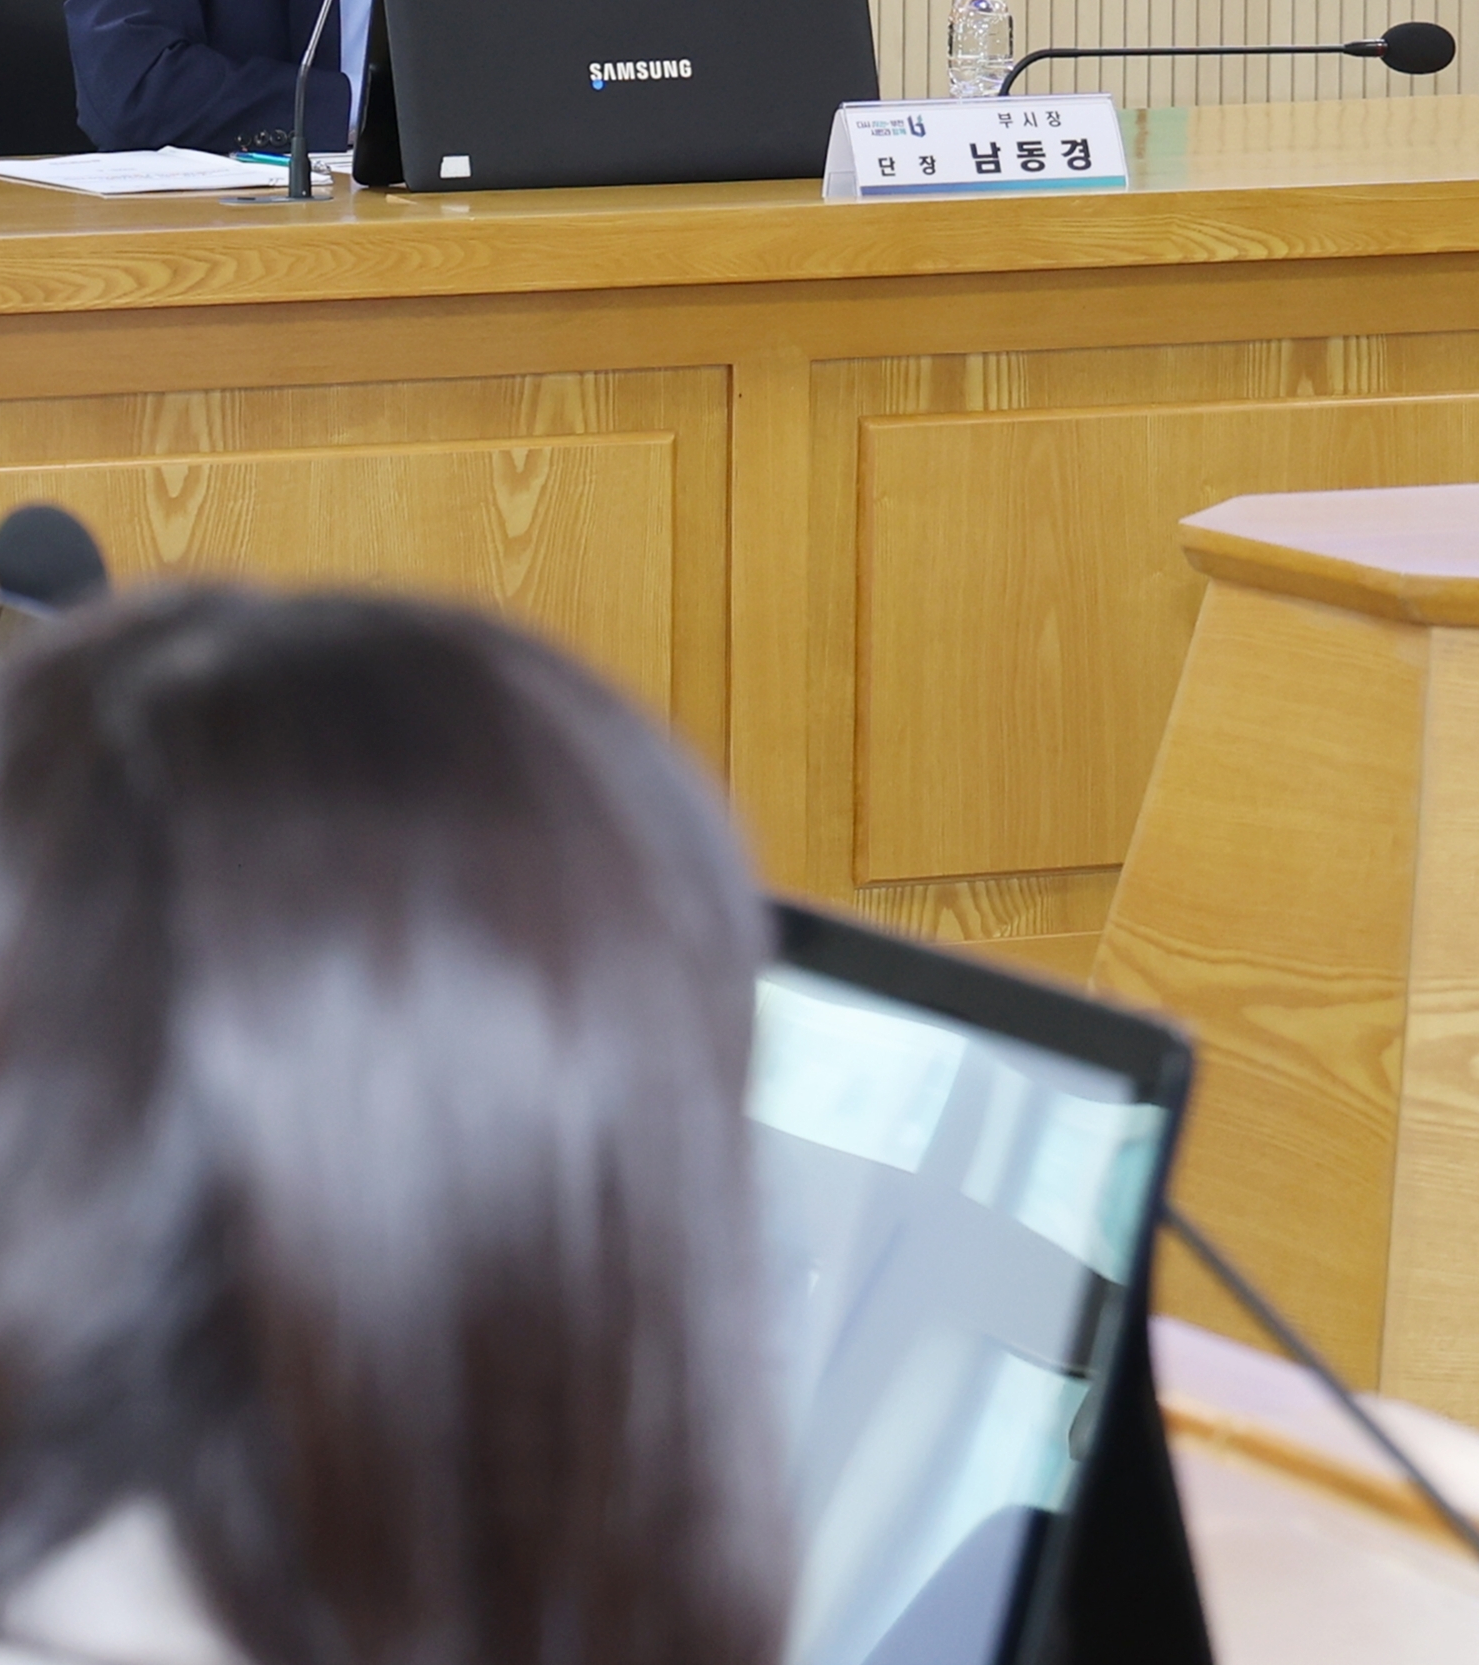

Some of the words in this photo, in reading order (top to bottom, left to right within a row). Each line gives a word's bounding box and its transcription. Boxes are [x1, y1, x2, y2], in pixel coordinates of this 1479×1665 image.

[589, 58, 694, 82] SAMSUNG
[998, 110, 1062, 129] 부시장
[969, 138, 1092, 175] 남동경
